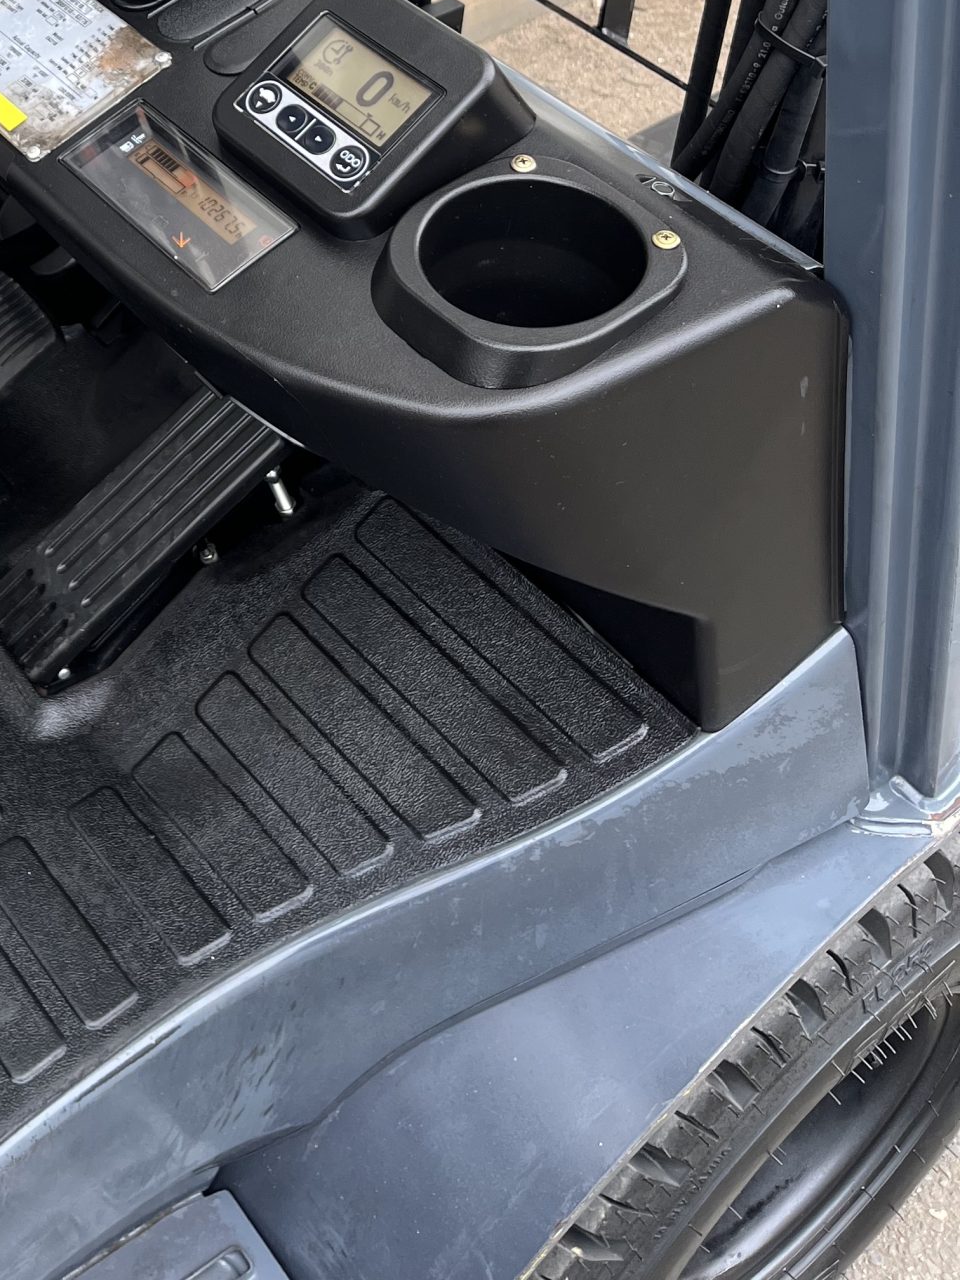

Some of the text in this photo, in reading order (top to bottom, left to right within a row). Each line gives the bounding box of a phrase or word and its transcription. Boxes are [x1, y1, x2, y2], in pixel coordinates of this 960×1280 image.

[308, 81, 318, 91] C
[375, 130, 387, 141] H
[355, 70, 411, 113] 0 km/h
[339, 148, 362, 168] ODO
